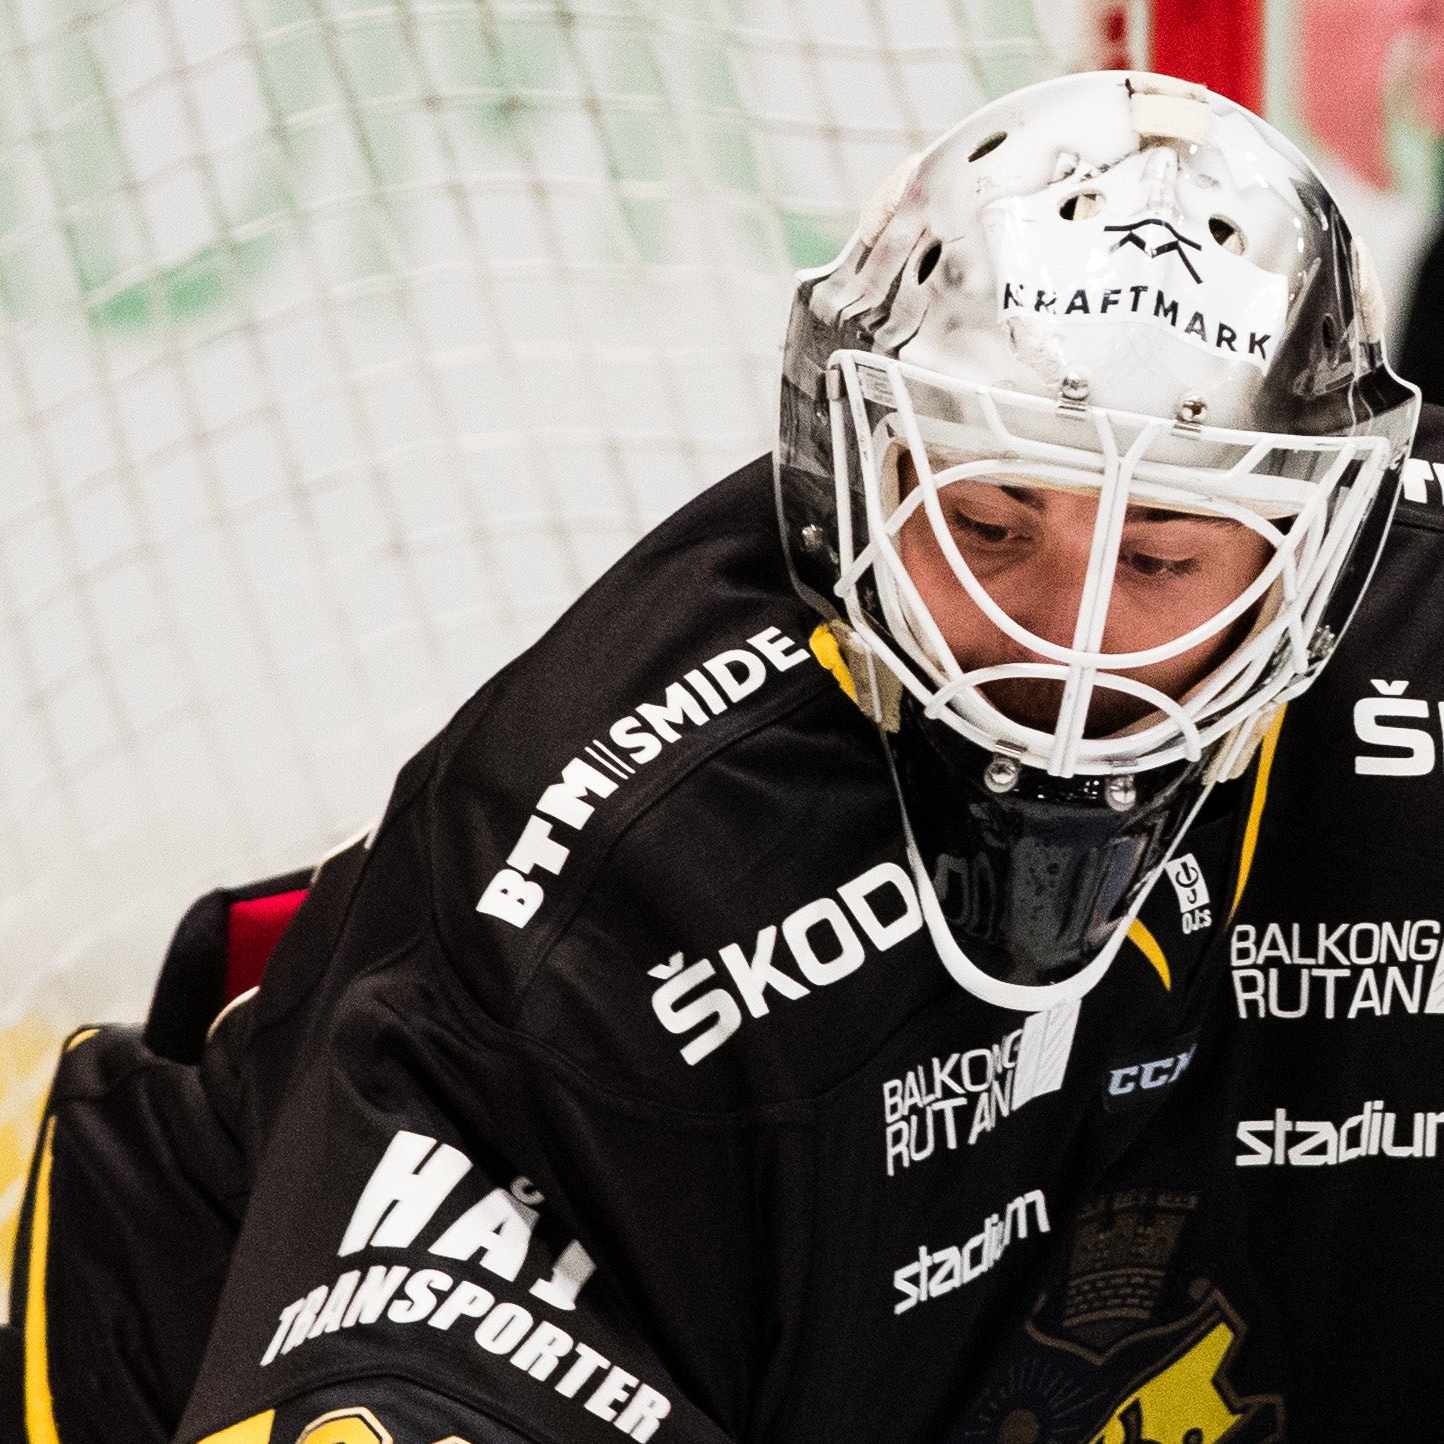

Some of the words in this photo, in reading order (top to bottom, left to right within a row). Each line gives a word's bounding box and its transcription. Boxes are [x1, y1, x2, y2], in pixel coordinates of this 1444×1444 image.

[1002, 281, 1273, 361] KRAFTMARK
[648, 862, 924, 1066] ŠKOD
[1230, 919, 1441, 967] BALKONG
[1231, 964, 1424, 1019] RUTAN
[885, 1069, 1014, 1177] RUTAN
